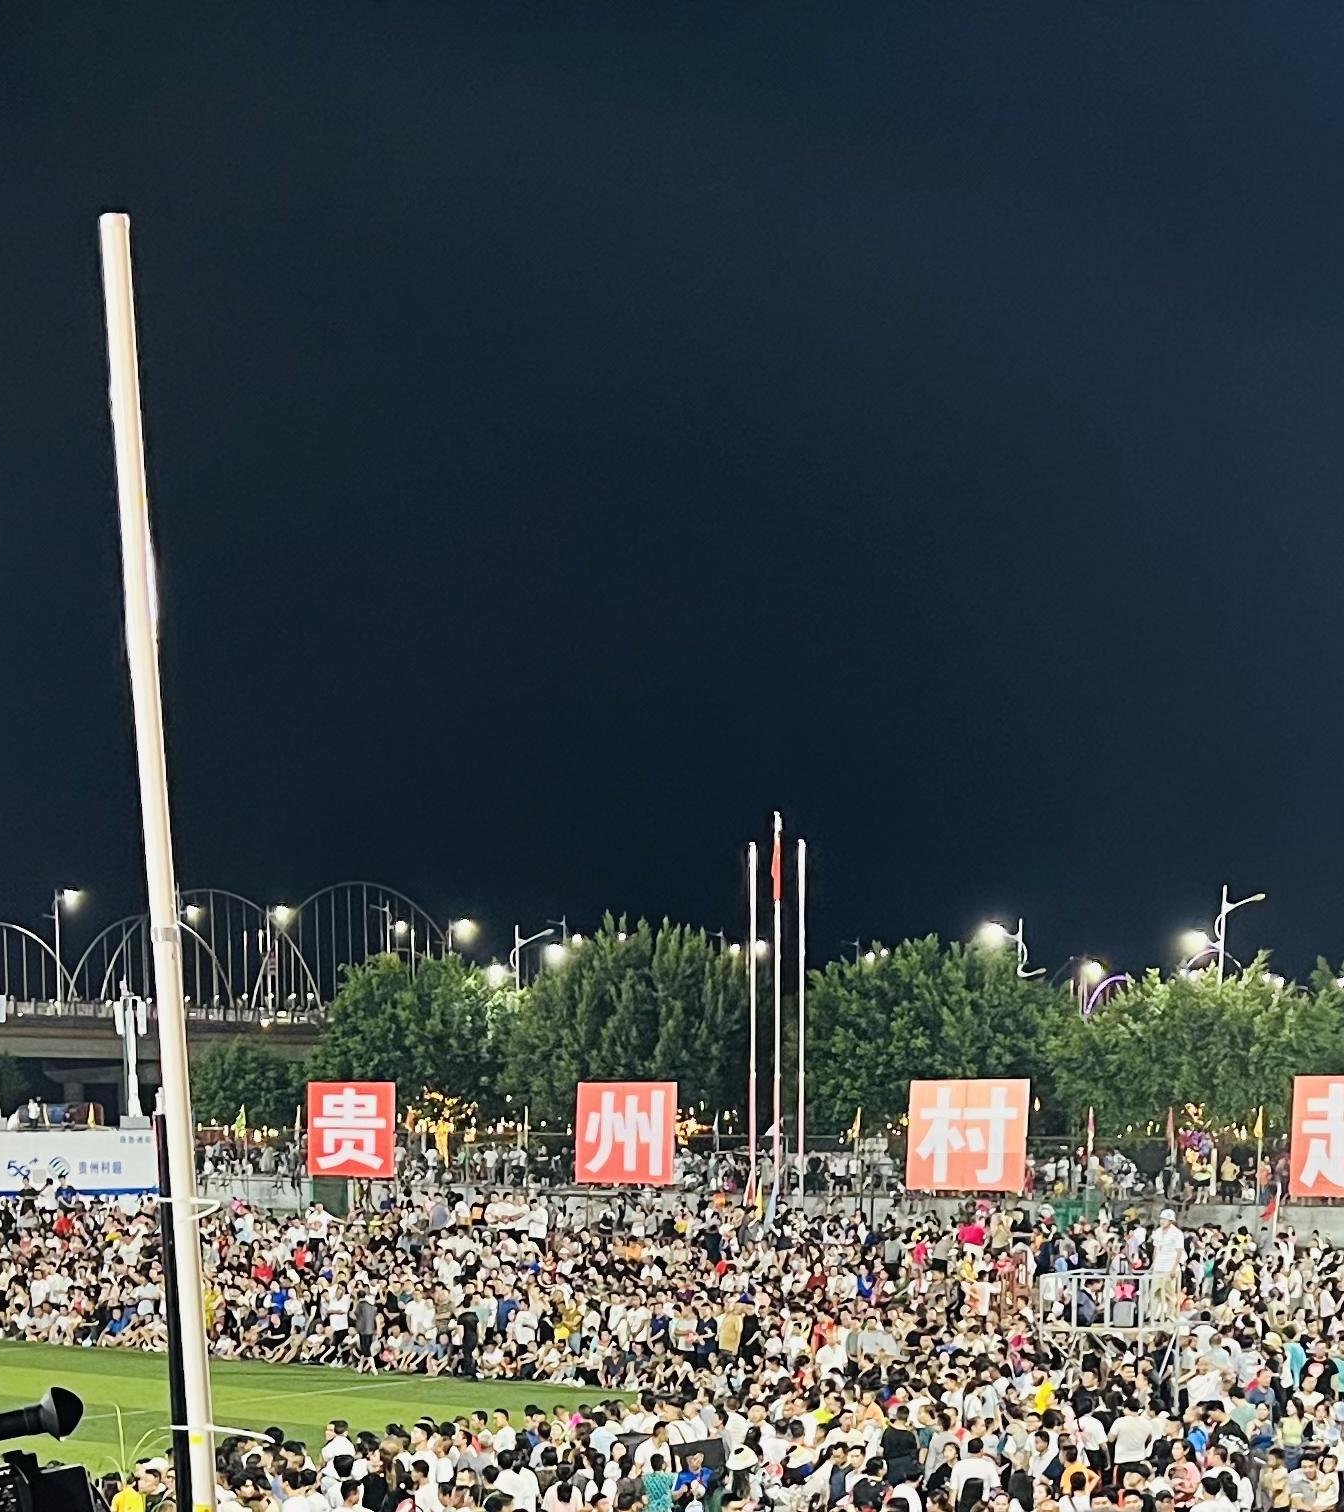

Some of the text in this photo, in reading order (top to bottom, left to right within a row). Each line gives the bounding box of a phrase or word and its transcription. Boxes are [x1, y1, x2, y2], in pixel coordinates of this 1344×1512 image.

[313, 1087, 387, 1170] 贵
[585, 1089, 665, 1176] 州
[916, 1087, 1017, 1184] 村
